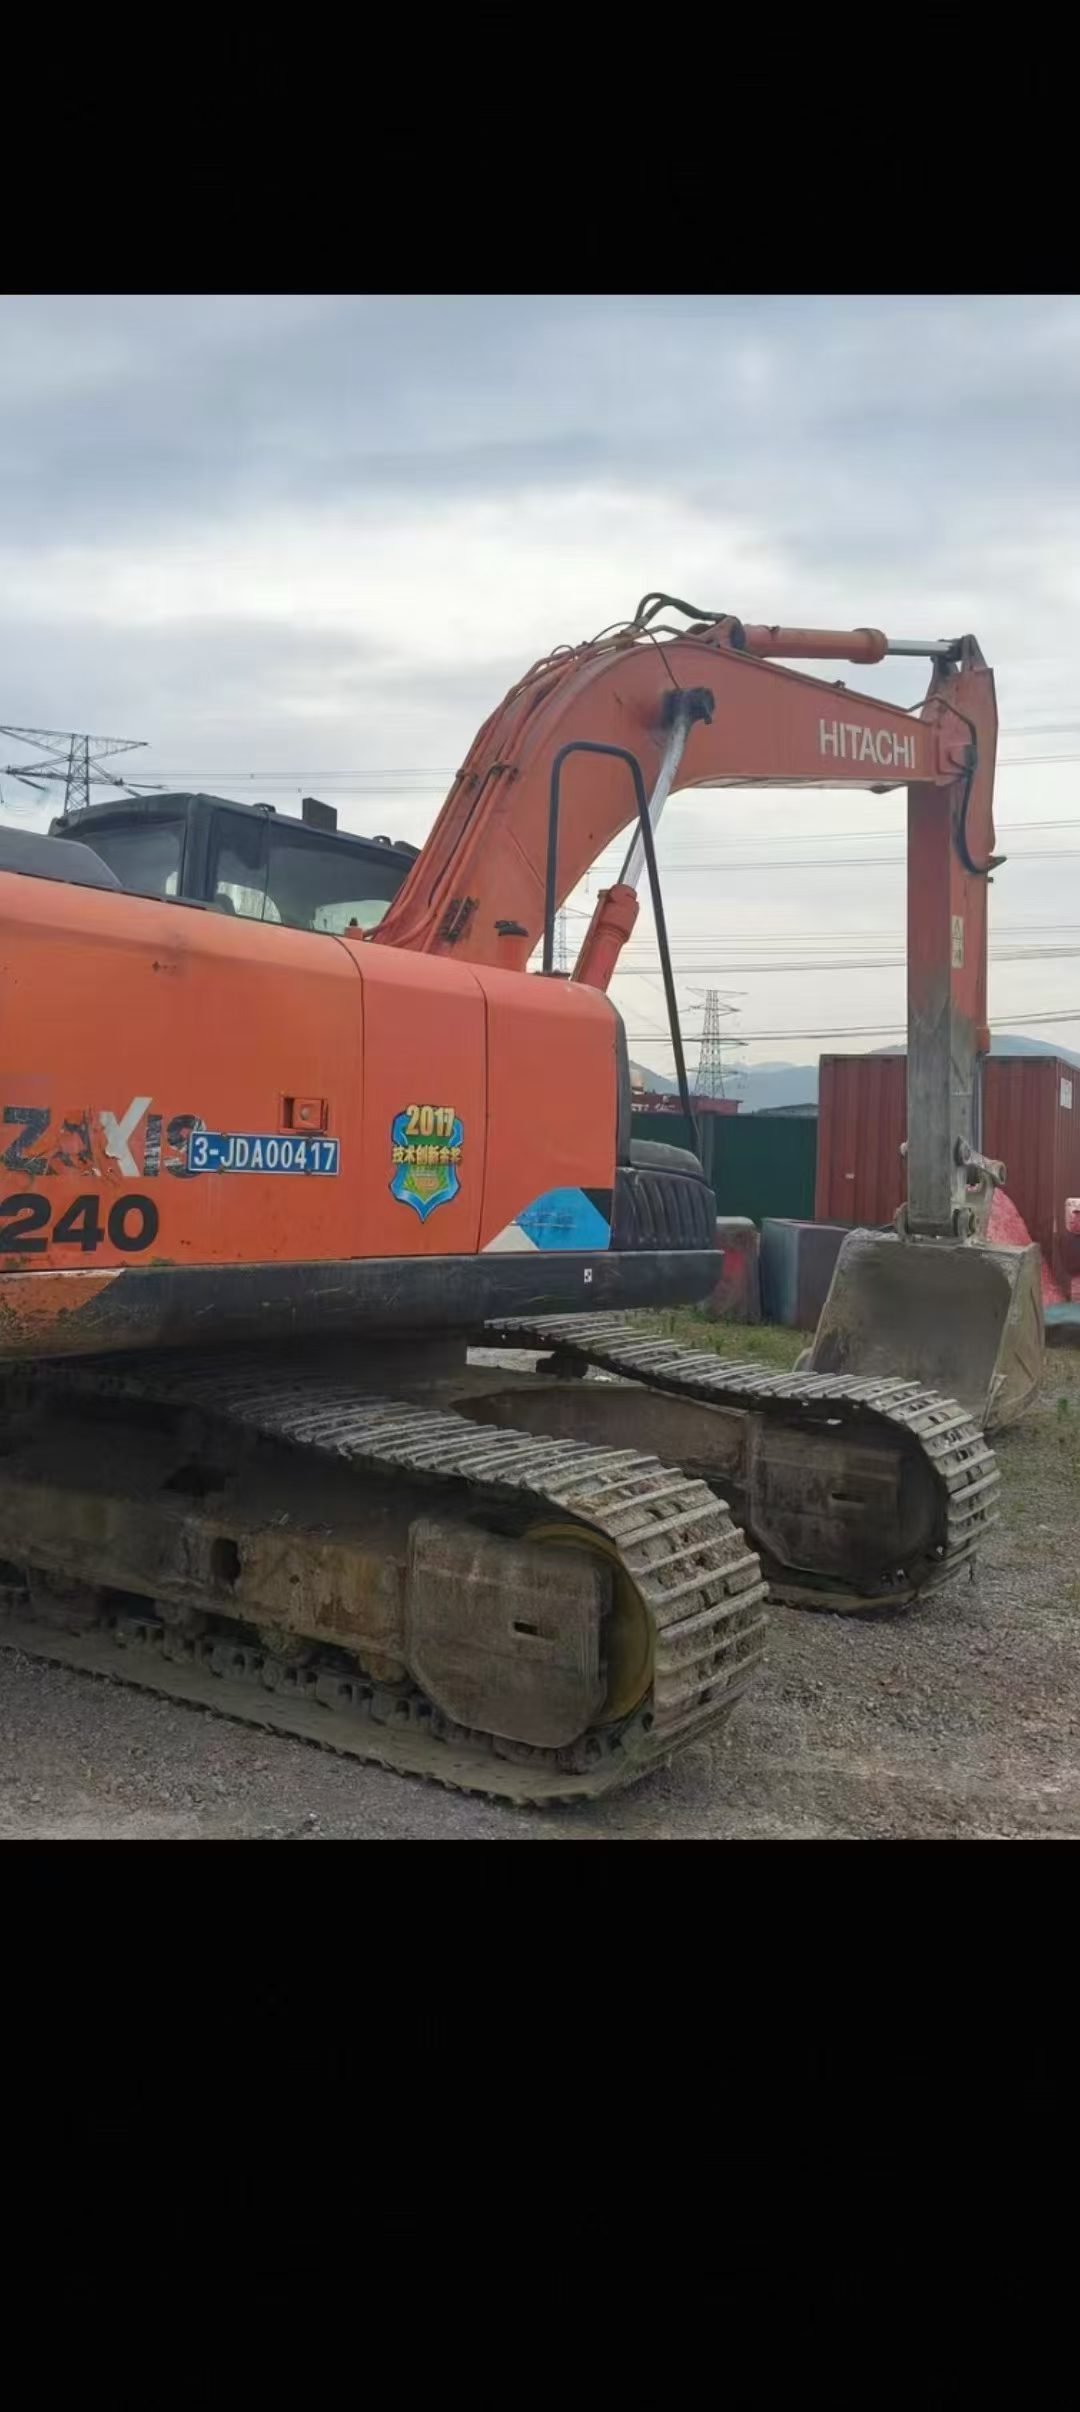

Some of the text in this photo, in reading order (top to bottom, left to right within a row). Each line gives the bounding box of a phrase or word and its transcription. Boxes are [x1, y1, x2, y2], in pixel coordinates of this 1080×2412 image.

[819, 719, 916, 769] HITACHI
[406, 1104, 456, 1138] 2017
[193, 1136, 336, 1171] 3-JDA00417
[392, 1144, 463, 1165] 技术创新金奖
[0, 1192, 159, 1253] 240
